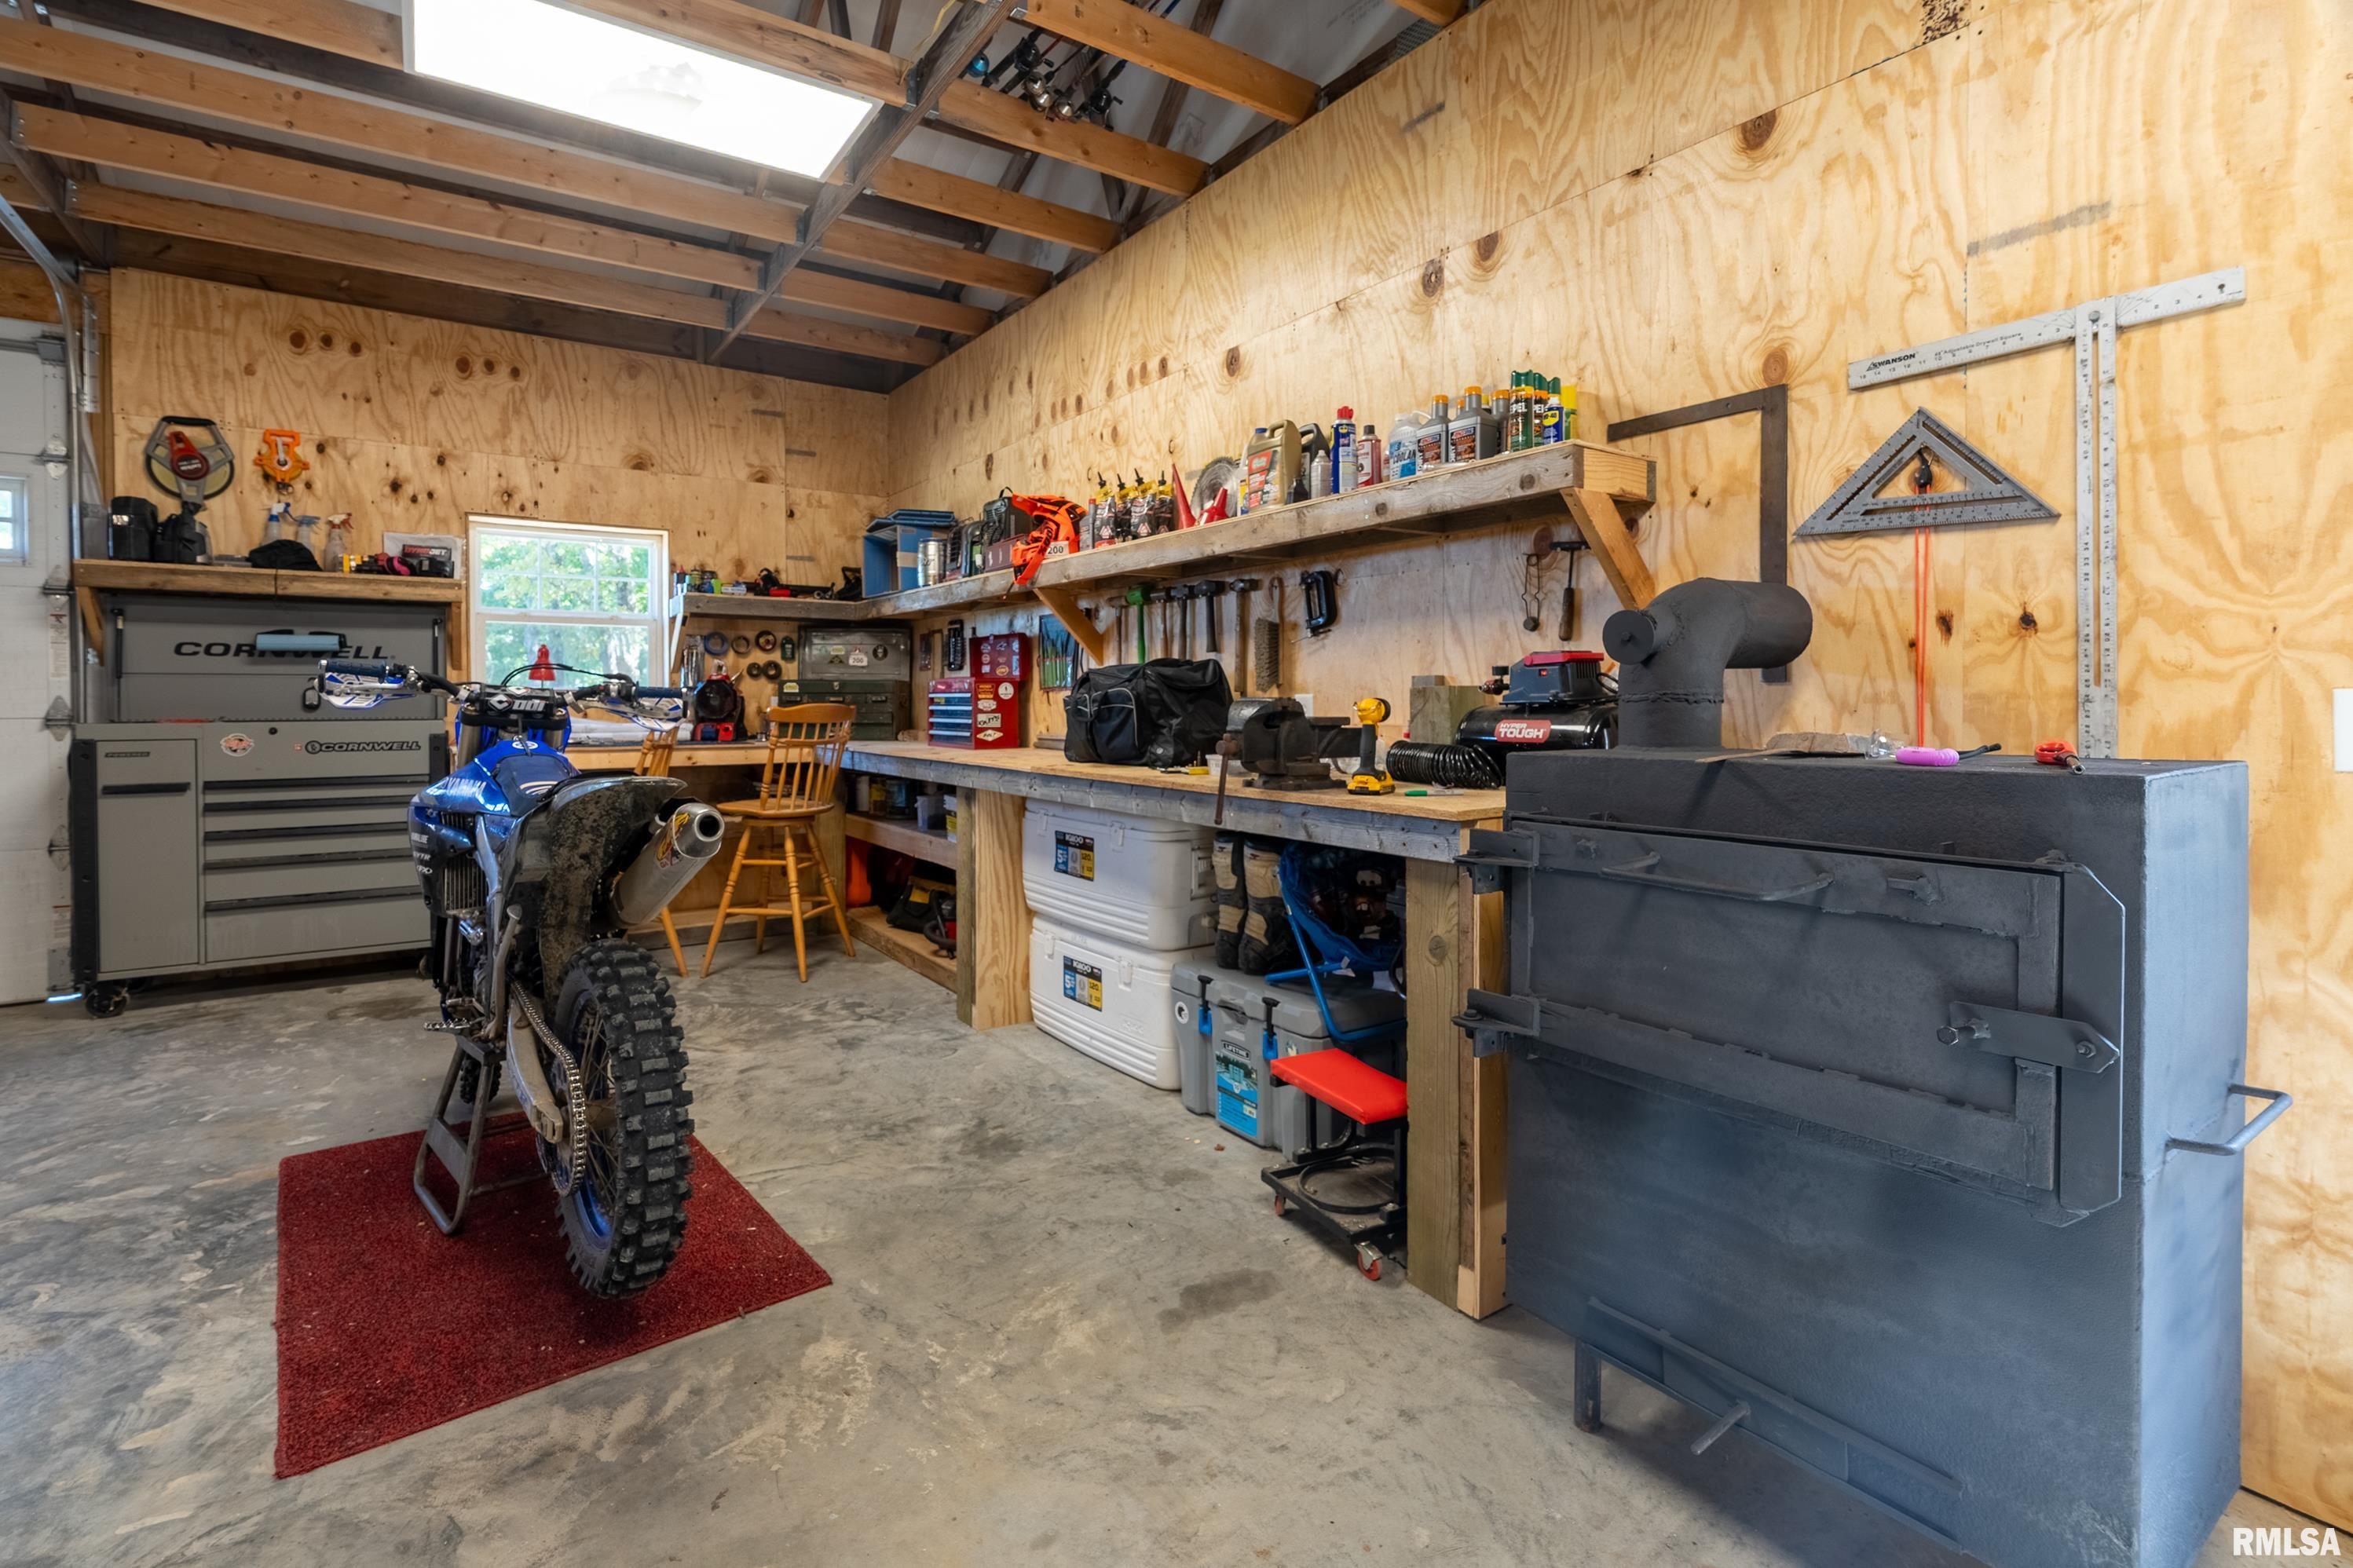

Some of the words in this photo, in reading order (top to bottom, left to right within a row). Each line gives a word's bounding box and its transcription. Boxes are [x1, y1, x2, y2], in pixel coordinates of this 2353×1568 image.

[1872, 353, 1916, 368] SWANSON
[1048, 546, 1064, 554] 200
[1499, 729, 1545, 739] TOUGH
[320, 741, 422, 752] CORNWELL
